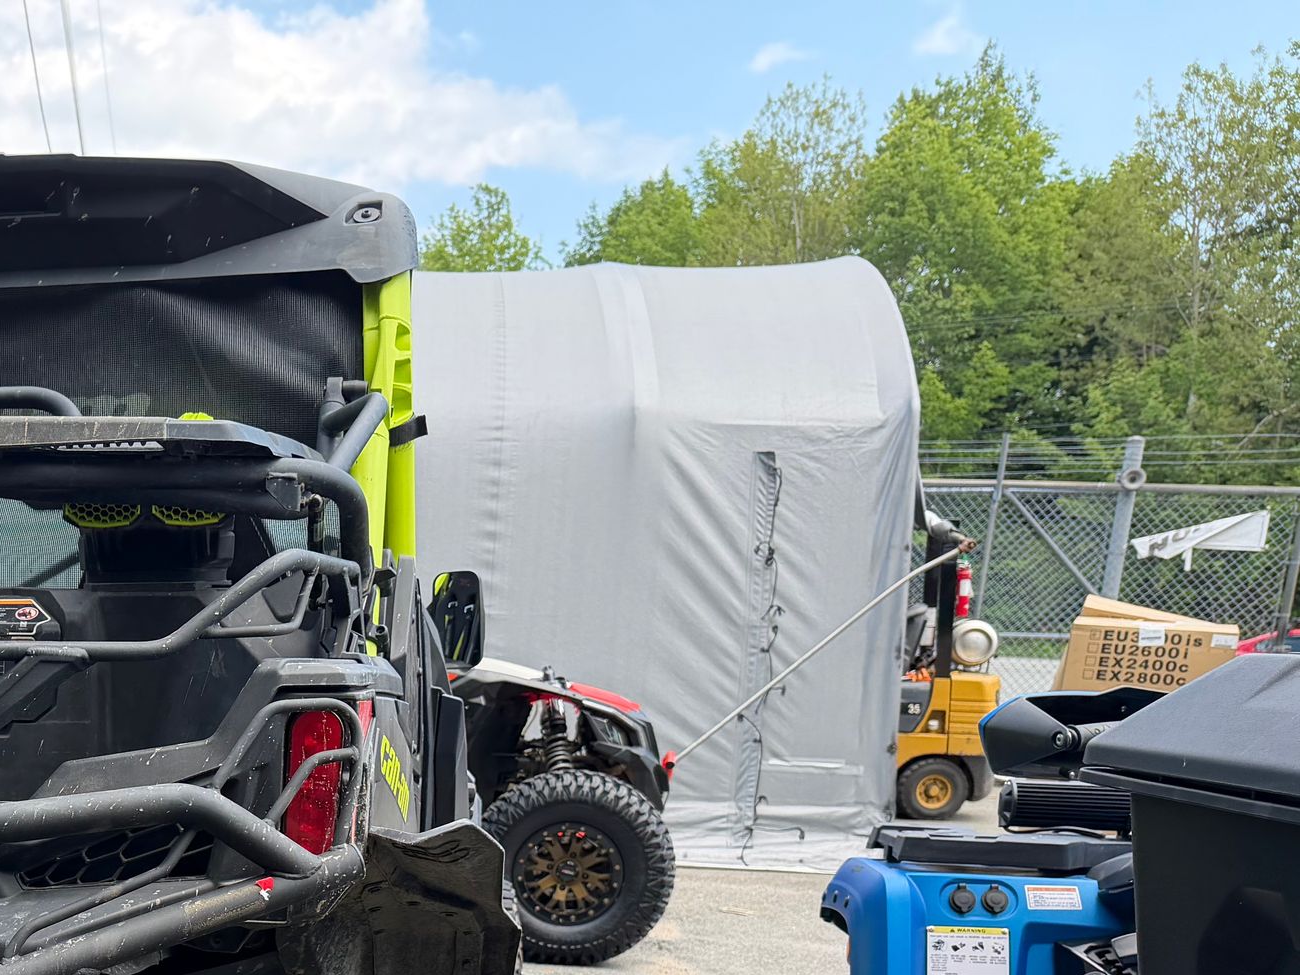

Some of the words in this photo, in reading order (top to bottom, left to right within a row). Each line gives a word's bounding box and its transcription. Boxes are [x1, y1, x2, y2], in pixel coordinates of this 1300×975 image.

[1103, 629, 1203, 648] EU30is
[1100, 643, 1189, 660] EU2600i
[1098, 656, 1189, 673] EX2400c
[1095, 669, 1187, 687] EX2800c
